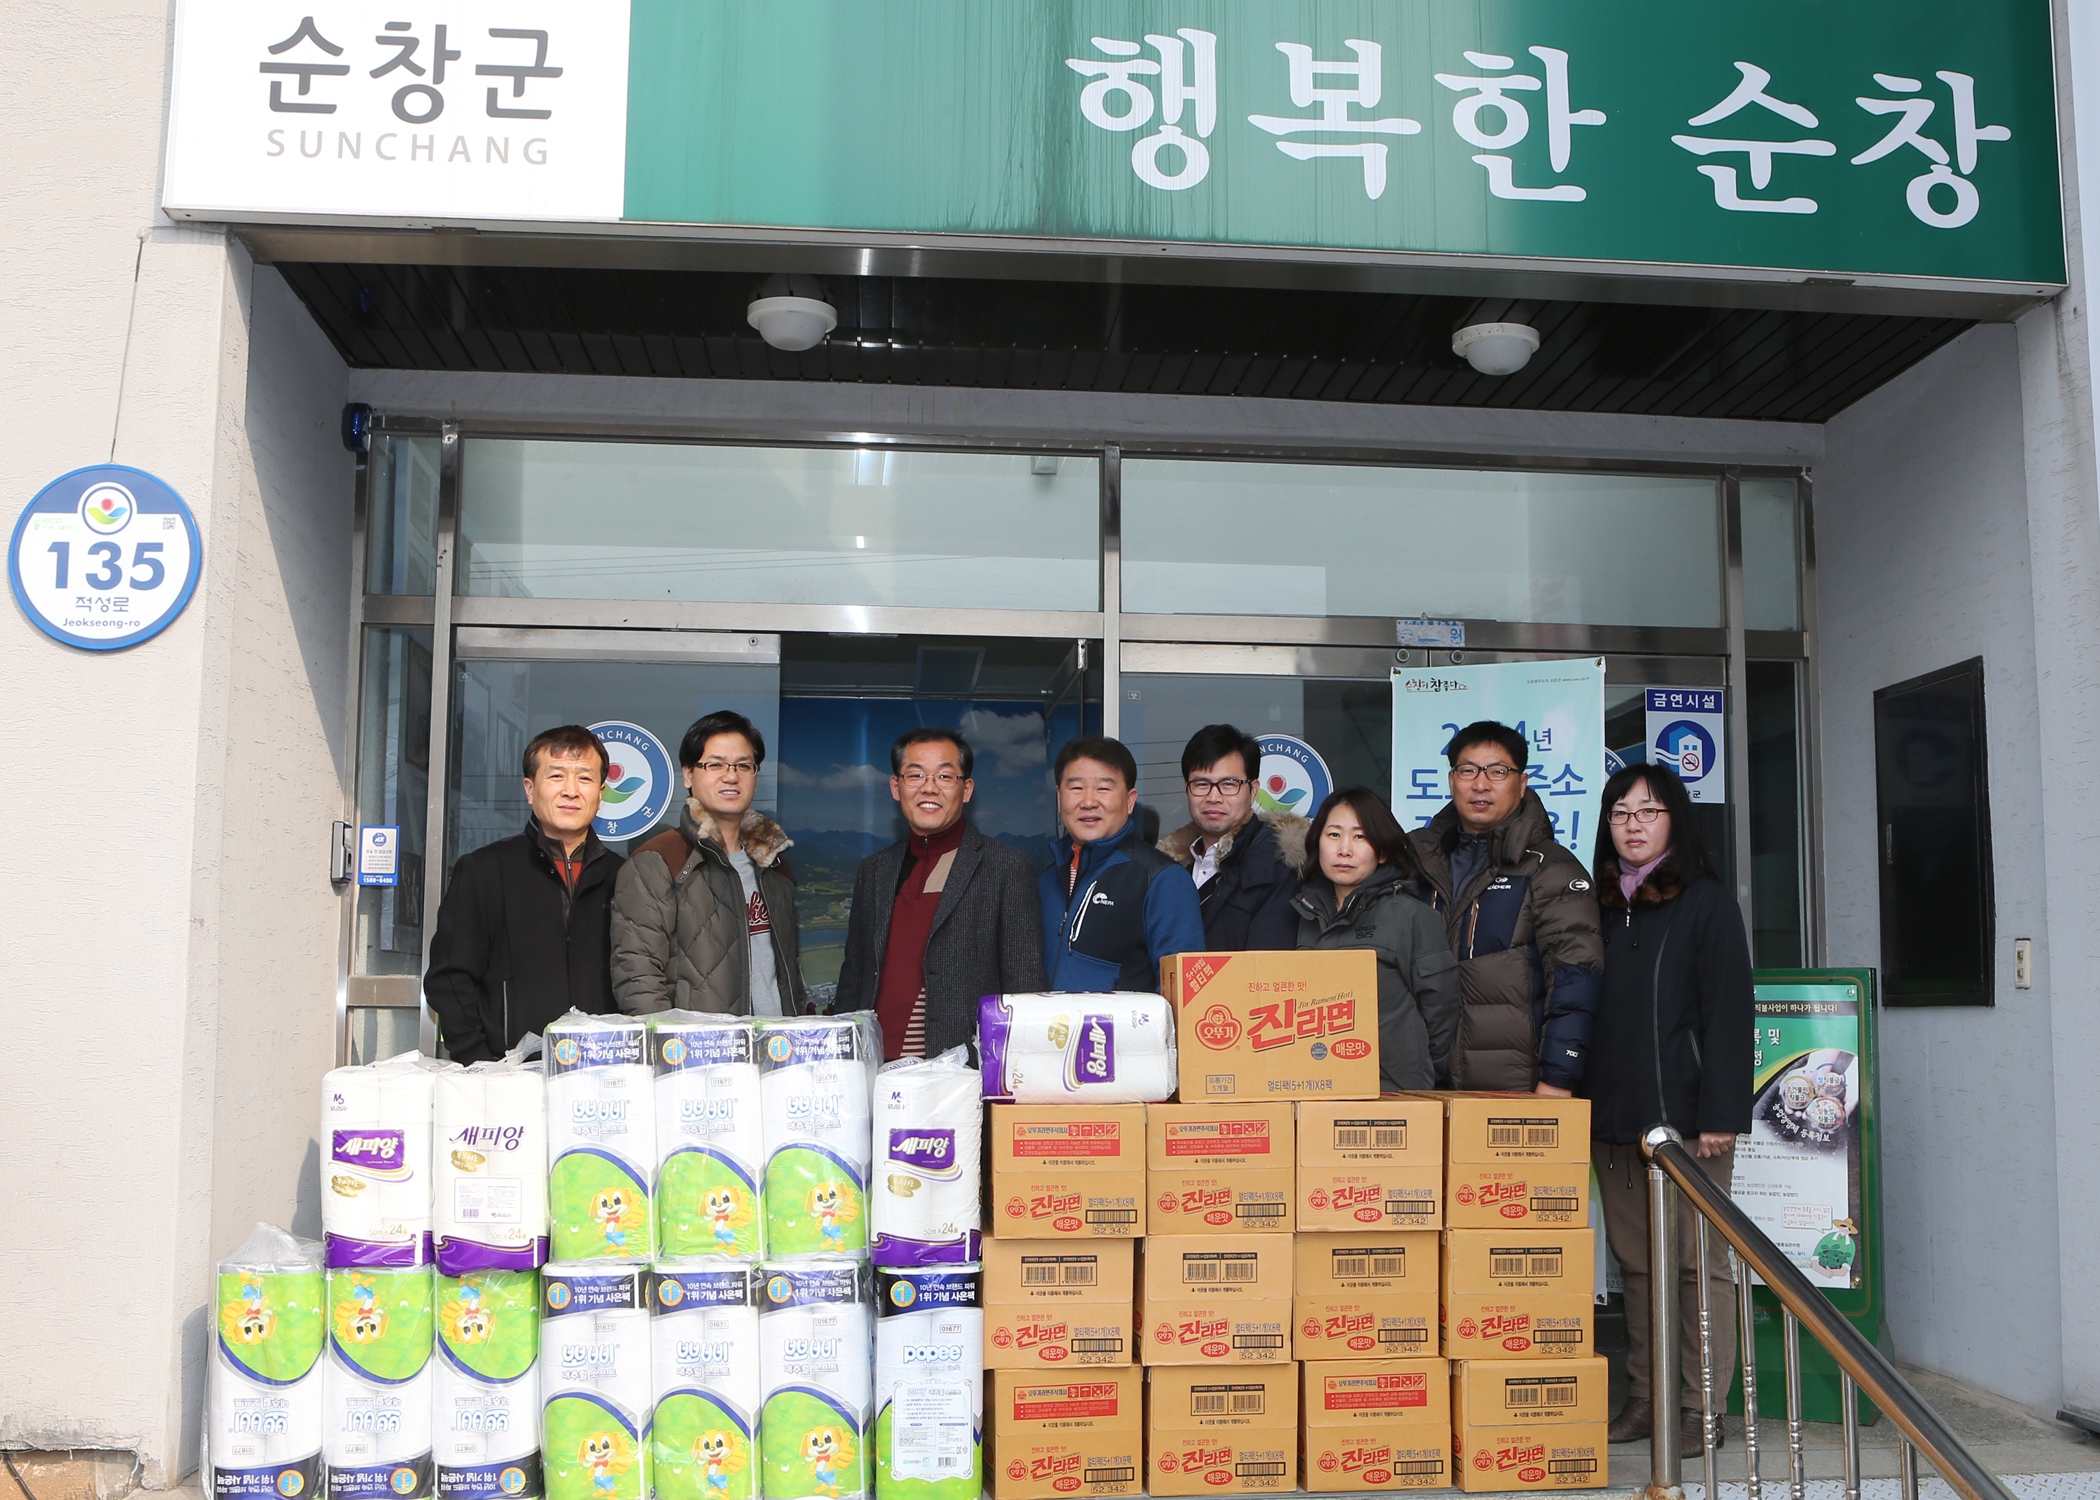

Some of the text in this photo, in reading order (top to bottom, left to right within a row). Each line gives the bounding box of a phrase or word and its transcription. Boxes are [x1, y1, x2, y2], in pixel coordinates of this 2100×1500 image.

[259, 16, 563, 124] 순창군
[1066, 28, 2011, 229] 행복한 순창
[266, 128, 549, 165] SUNCHANG
[47, 541, 165, 590] 135
[76, 597, 129, 612] 적성로
[63, 618, 140, 629] Jeokseong-ro
[1653, 693, 1715, 708] 금연시설
[597, 730, 649, 751] NCHANG
[1441, 721, 1552, 755] 24년
[1259, 743, 1309, 764] NCHANG
[1407, 764, 1587, 799] 도주소
[1248, 982, 1307, 992] 진하고 얼큰한 맛!
[1298, 1000, 1309, 1009] Jin
[1204, 1026, 1234, 1039] 오뚜기
[1247, 998, 1355, 1052] 진라면
[1768, 1029, 1780, 1045] 및
[1336, 1042, 1365, 1056] 매운맛
[335, 1137, 399, 1159] 새피앙
[449, 1126, 526, 1151] 새피앙
[892, 1137, 950, 1157] 새피앙
[1181, 1189, 1232, 1215] 진라면
[1332, 1184, 1382, 1210] 진라면
[1478, 1182, 1527, 1207] 진라면
[1030, 1193, 1081, 1219] 진라면
[1356, 1210, 1379, 1220] 매운맛
[1502, 1206, 1525, 1216] 매운맛
[1056, 1219, 1079, 1229] 매운맛
[1207, 1213, 1230, 1223] 매운맛
[574, 1291, 631, 1304] 1위 기념 사은팩
[686, 1289, 743, 1301] 1위 기념 사은팩
[795, 1286, 852, 1298] 1위 기념 사은팩
[919, 1291, 975, 1302] 1위 기념 사은팩
[1016, 1322, 1068, 1348] 진라면
[1178, 1320, 1230, 1348] 진라면
[1324, 1315, 1374, 1338] 진라면
[1480, 1315, 1530, 1338] 진라면
[1204, 1345, 1227, 1354] 매운맛
[1350, 1338, 1372, 1348] 매운맛
[1506, 1340, 1528, 1349] 매운맛
[903, 1345, 962, 1364] popee
[1042, 1348, 1065, 1358] 매운맛
[1181, 1449, 1232, 1474] 진라면
[1341, 1446, 1391, 1473] 진라면
[1496, 1446, 1546, 1472] 진라면
[1030, 1456, 1082, 1482] 진라면
[1207, 1472, 1230, 1482] 매운맛
[1366, 1472, 1388, 1482] 매운맛
[1520, 1469, 1543, 1479] 매운맛
[1056, 1479, 1078, 1490] 매운맛
